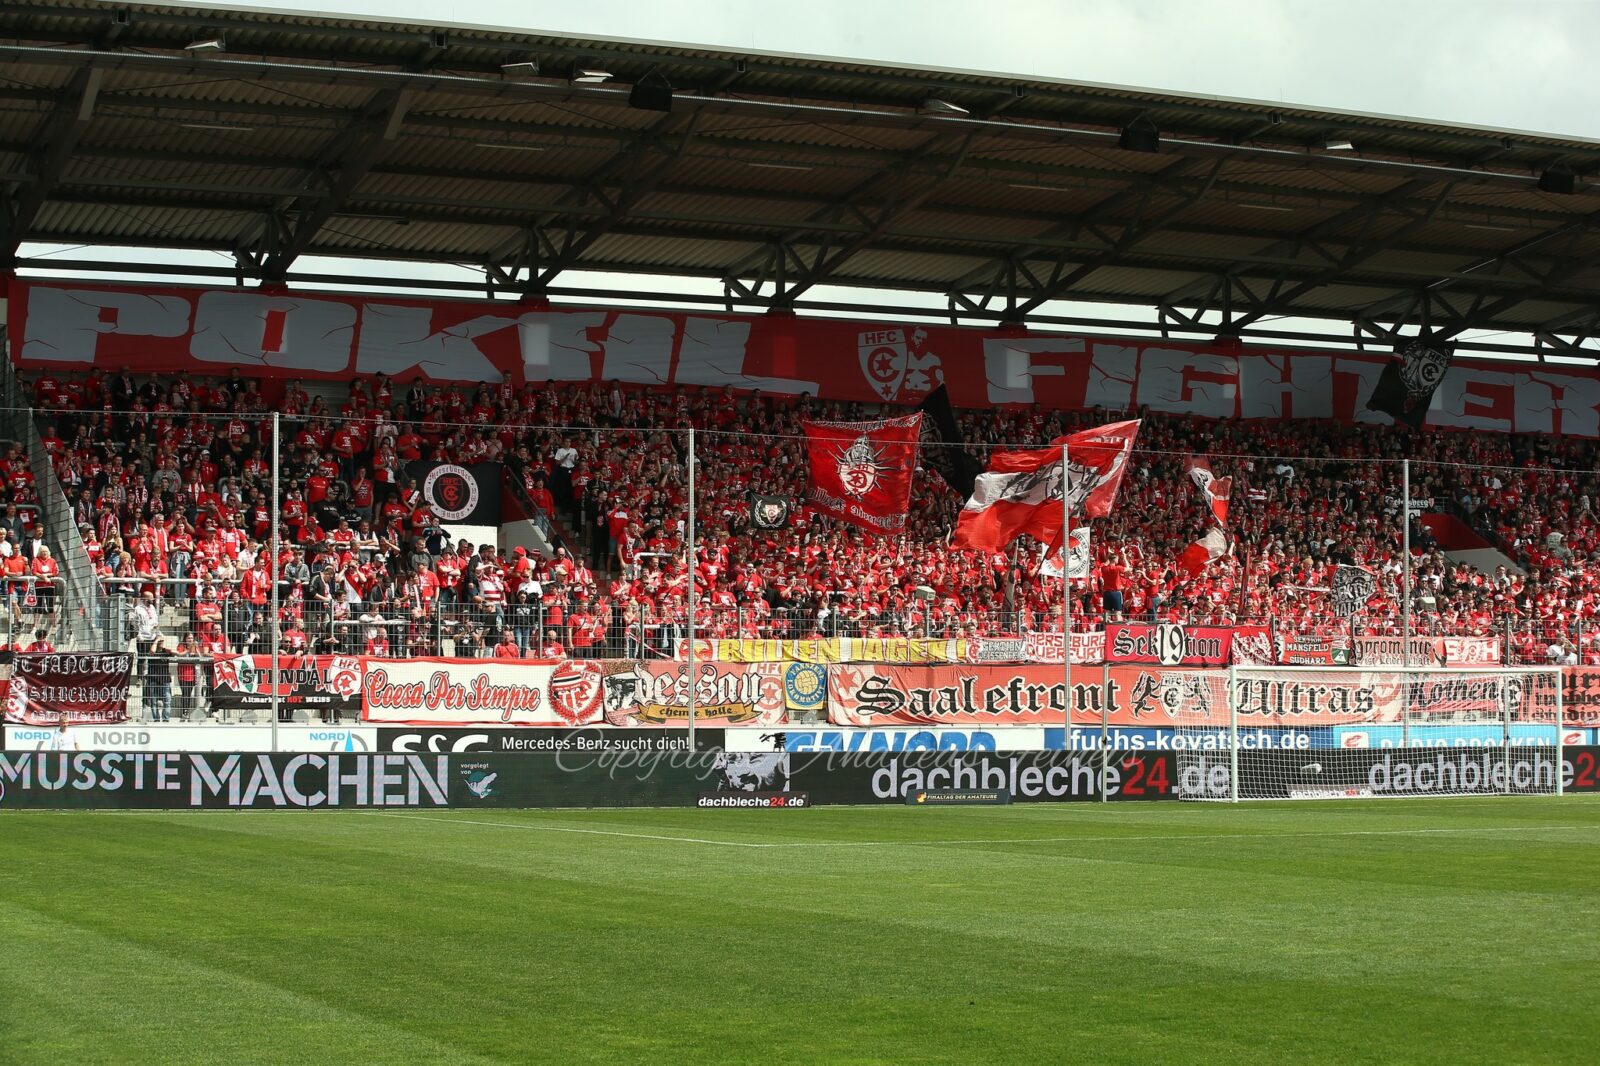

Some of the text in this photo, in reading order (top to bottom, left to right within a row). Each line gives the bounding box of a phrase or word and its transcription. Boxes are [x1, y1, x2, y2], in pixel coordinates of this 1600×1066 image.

[21, 286, 820, 397] POKAL
[865, 331, 897, 344] HFC
[1287, 643, 1329, 652] MANSFELD
[339, 658, 360, 671] HFC
[1289, 655, 1326, 664] SÜDHARZ
[633, 662, 765, 708] Dessau
[426, 671, 467, 709] Per
[467, 673, 541, 722] Sempre
[856, 675, 1121, 718] Saalefront
[659, 705, 699, 717] cheme
[14, 732, 52, 740] NORD
[93, 731, 151, 745] NORD
[309, 732, 345, 741] NORD
[502, 736, 690, 750] Mercedes-Benz sucht dich!
[1070, 729, 1310, 750] fuchs-kovatsch.de
[871, 755, 1230, 798] dachbleche24.de
[1369, 752, 1600, 790] dachbleche2
[0, 752, 449, 806] MUSSTE MACHEN
[698, 796, 804, 807] dachbleche24.de
